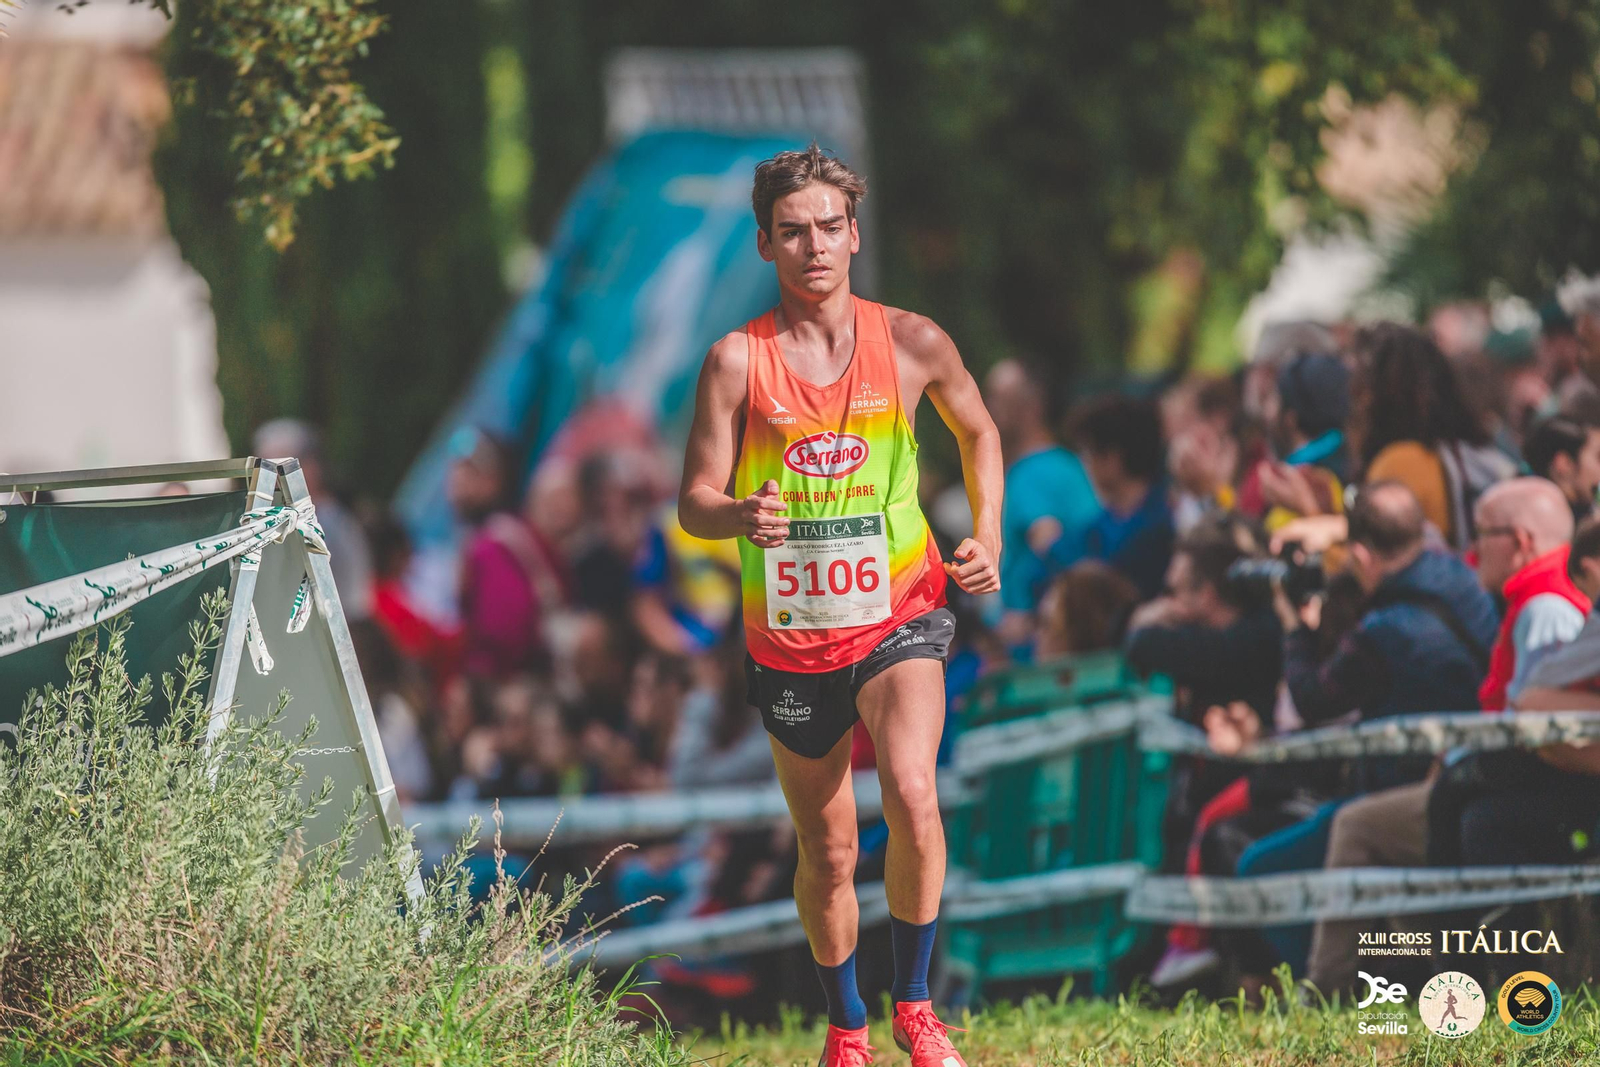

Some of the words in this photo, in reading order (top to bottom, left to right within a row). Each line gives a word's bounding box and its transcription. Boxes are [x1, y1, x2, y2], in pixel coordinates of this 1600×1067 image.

[768, 416, 796, 424] rasán
[793, 445, 863, 466] Serrano
[782, 491, 810, 502] COME
[814, 491, 836, 502] BIEN
[846, 484, 875, 498] CORRE
[796, 522, 852, 536] ITÁLICA
[778, 556, 880, 597] 5106
[772, 704, 812, 716] SERRANO
